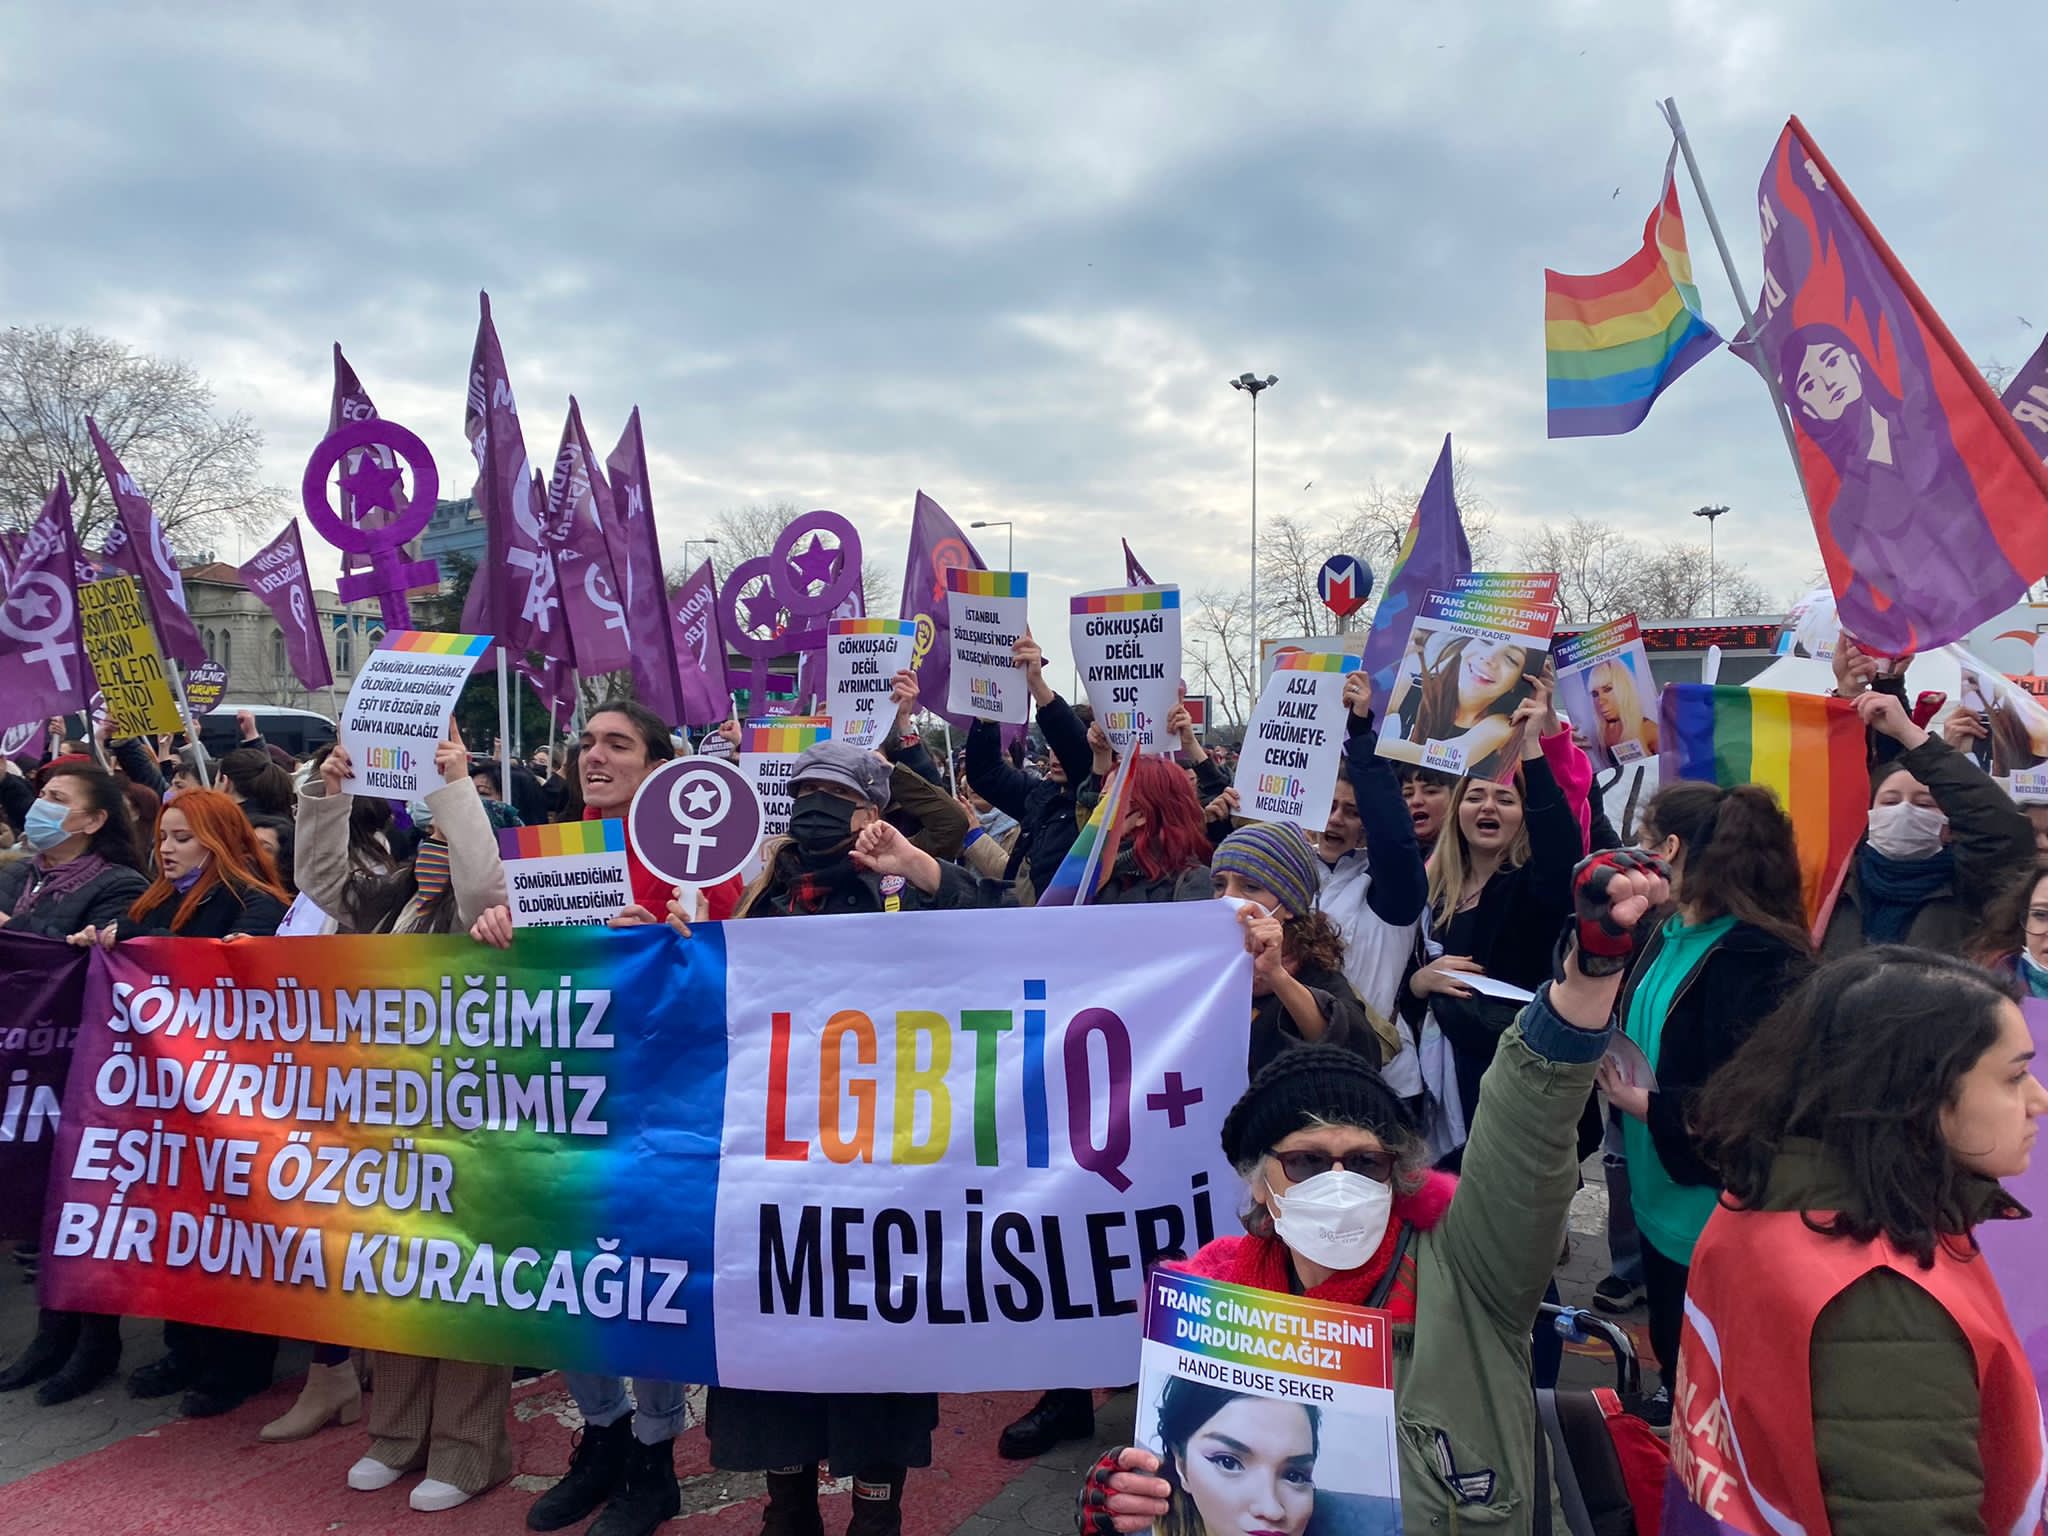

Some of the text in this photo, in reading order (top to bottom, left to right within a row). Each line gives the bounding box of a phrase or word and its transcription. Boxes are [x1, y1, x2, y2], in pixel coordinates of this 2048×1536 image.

[1455, 578, 1484, 588] TRANS
[965, 606, 1001, 624] İSTANBUL
[1430, 594, 1550, 622] TRANS CİNAYETLERİNİ
[1440, 608, 1531, 631] DURDURACAĞIZ!
[1086, 613, 1163, 638] GÖKKUŞAĞI
[1450, 624, 1511, 642] HANDE KADER
[838, 637, 898, 657] GÖKKUŞAĞI
[1106, 639, 1144, 660] DEĞİL
[368, 659, 466, 679] SÖMÜRÜLMEDİĞİMİZ
[852, 657, 879, 675] DEĞİL
[1088, 663, 1165, 682] AYRIMCILIK
[361, 676, 455, 697] ÖLDÜRÜLMEDİĞİMİZ
[1113, 687, 1139, 707] SUÇ
[1286, 678, 1317, 696] ASLA
[358, 696, 441, 717] EŞİT VE ÖZGÜR BİR
[856, 698, 874, 715] SUÇ
[1277, 700, 1318, 720] YALNIZ
[351, 716, 439, 739] DÜNYA KURACAĞIZ
[1104, 708, 1152, 731] LGBTİQ+
[366, 746, 416, 773] LGBTİQ+
[760, 760, 779, 777] BİZİ
[1265, 747, 1309, 770] CEKSİN
[366, 770, 417, 791] MECLİSLERİ
[1258, 773, 1305, 801] LGBTİQ+
[1255, 796, 1303, 817] MECLİSLERİ
[514, 866, 624, 890] SÖMÜRÜLMEDİĞİMİZ
[519, 890, 626, 913] ÖLDÜRÜLMEDİĞİMİZ
[107, 975, 615, 1050] SÖMÜRÜLMEDİĞİMİZ
[94, 1050, 609, 1136] ÖLDÜRÜLMEDİĞİMİZ
[765, 979, 1203, 1193] LGBTİQ+
[71, 1118, 454, 1214] EŞİT VE ÖZGÜR
[53, 1191, 689, 1325] BİR DÜNYA KURACAĞIZ
[1158, 1285, 1374, 1349] TRANS CİNAYETLERİNİ
[1176, 1318, 1342, 1371] DURDURACAĞIZ!
[1178, 1355, 1334, 1402] HANDE BUSE ŞEKER
